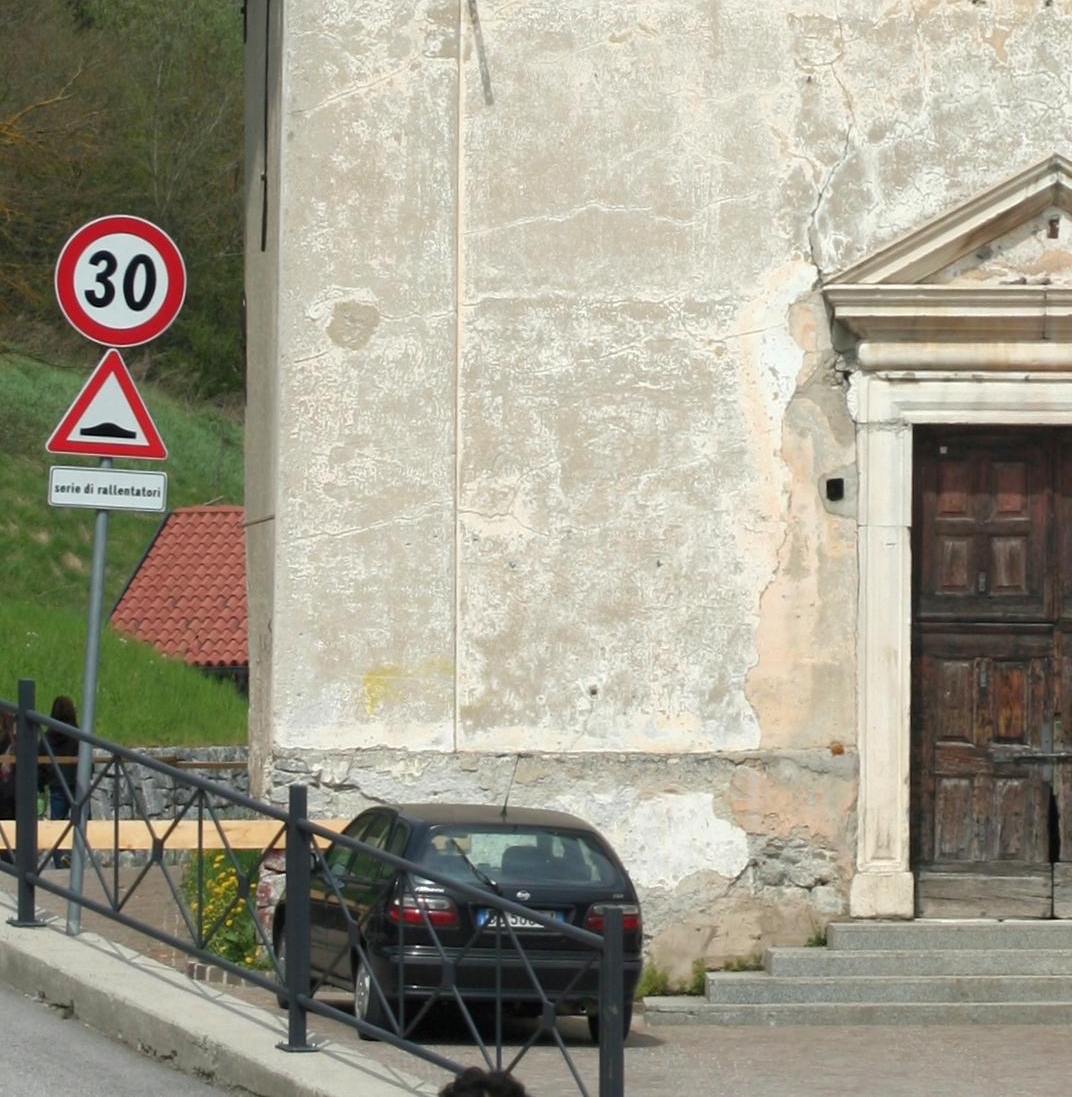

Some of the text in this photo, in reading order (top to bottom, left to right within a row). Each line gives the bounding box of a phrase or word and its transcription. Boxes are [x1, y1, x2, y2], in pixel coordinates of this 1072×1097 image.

[84, 249, 157, 312] 30
[54, 482, 161, 498] serie di rallentatori
